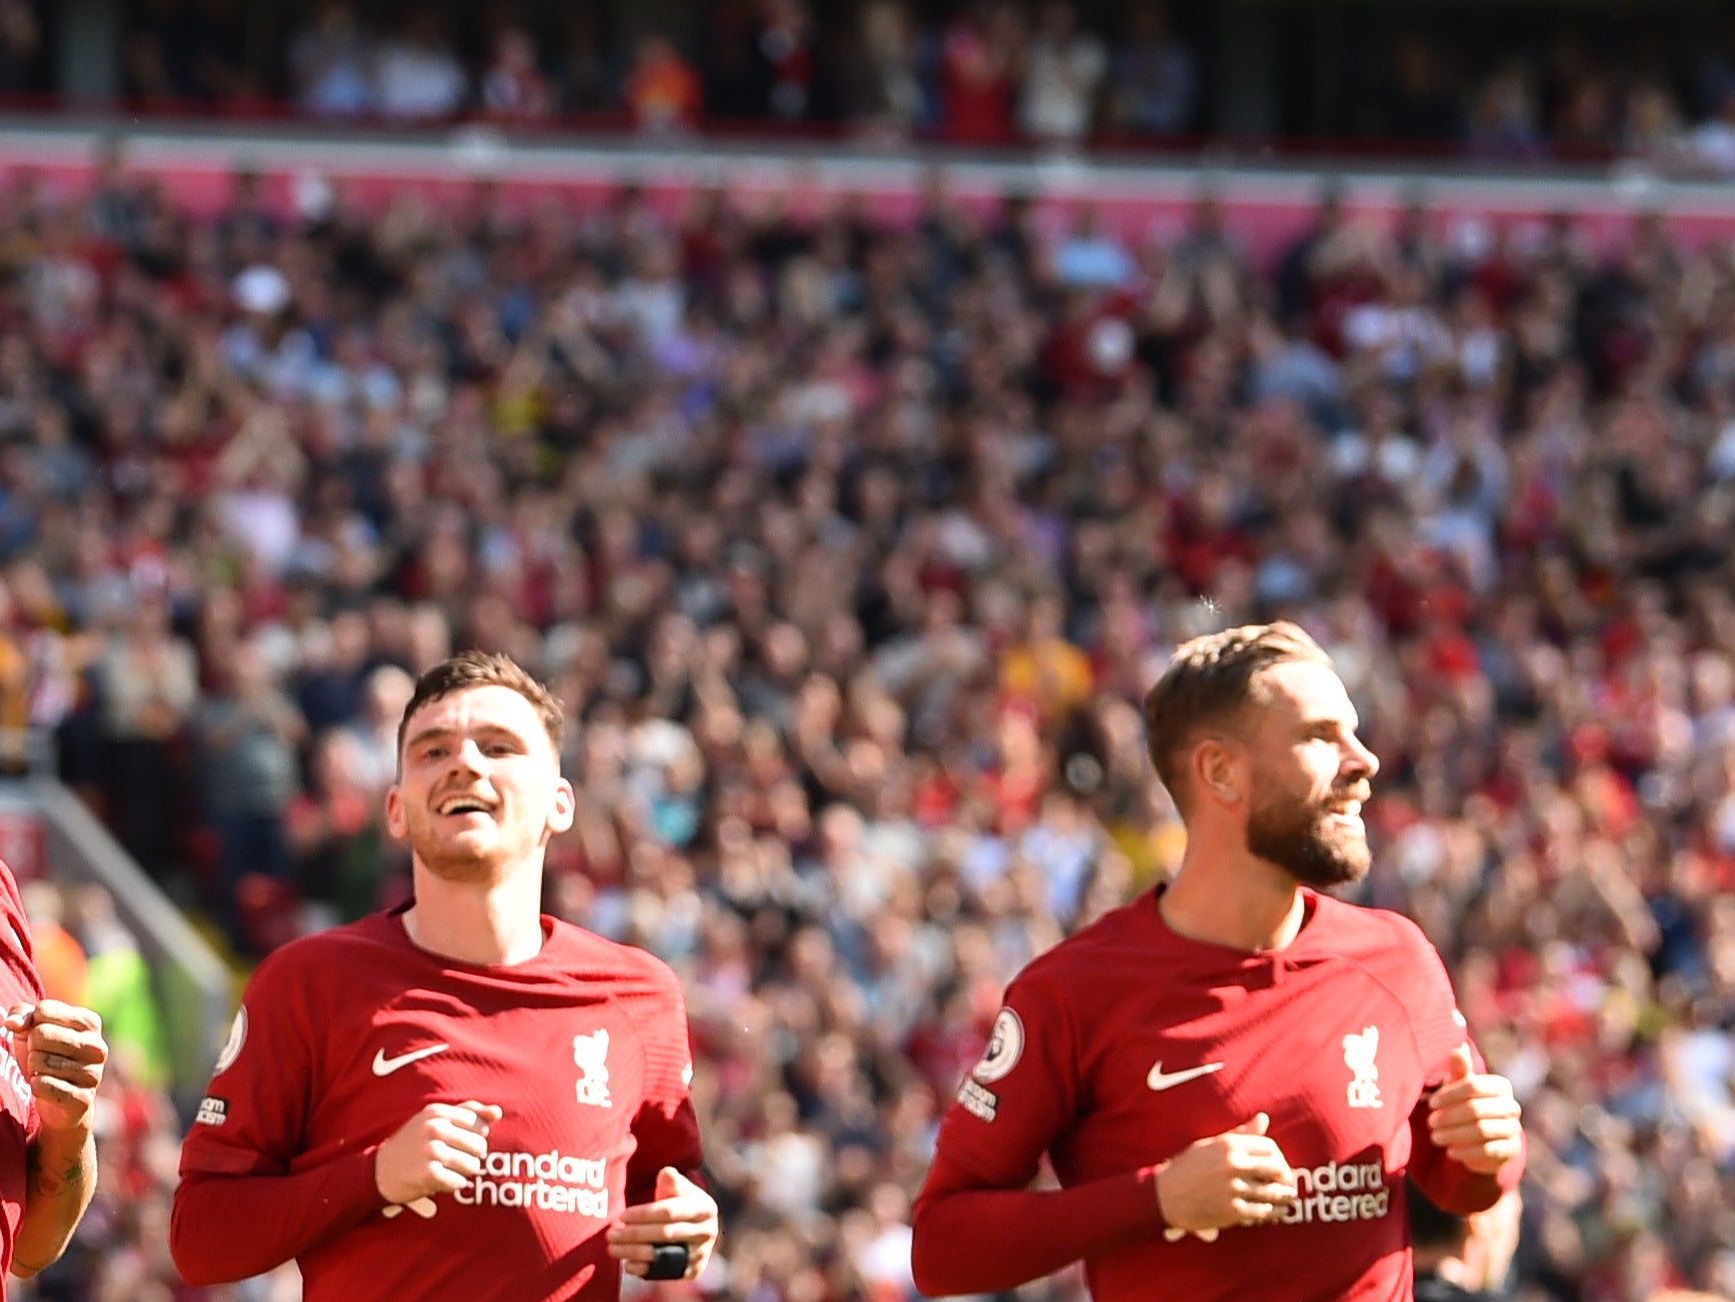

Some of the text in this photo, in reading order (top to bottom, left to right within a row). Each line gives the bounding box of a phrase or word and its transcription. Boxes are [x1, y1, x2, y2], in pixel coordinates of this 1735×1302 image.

[479, 1150, 606, 1188] andard
[1291, 1159, 1383, 1193] ndard
[1243, 1187, 1390, 1226] artered
